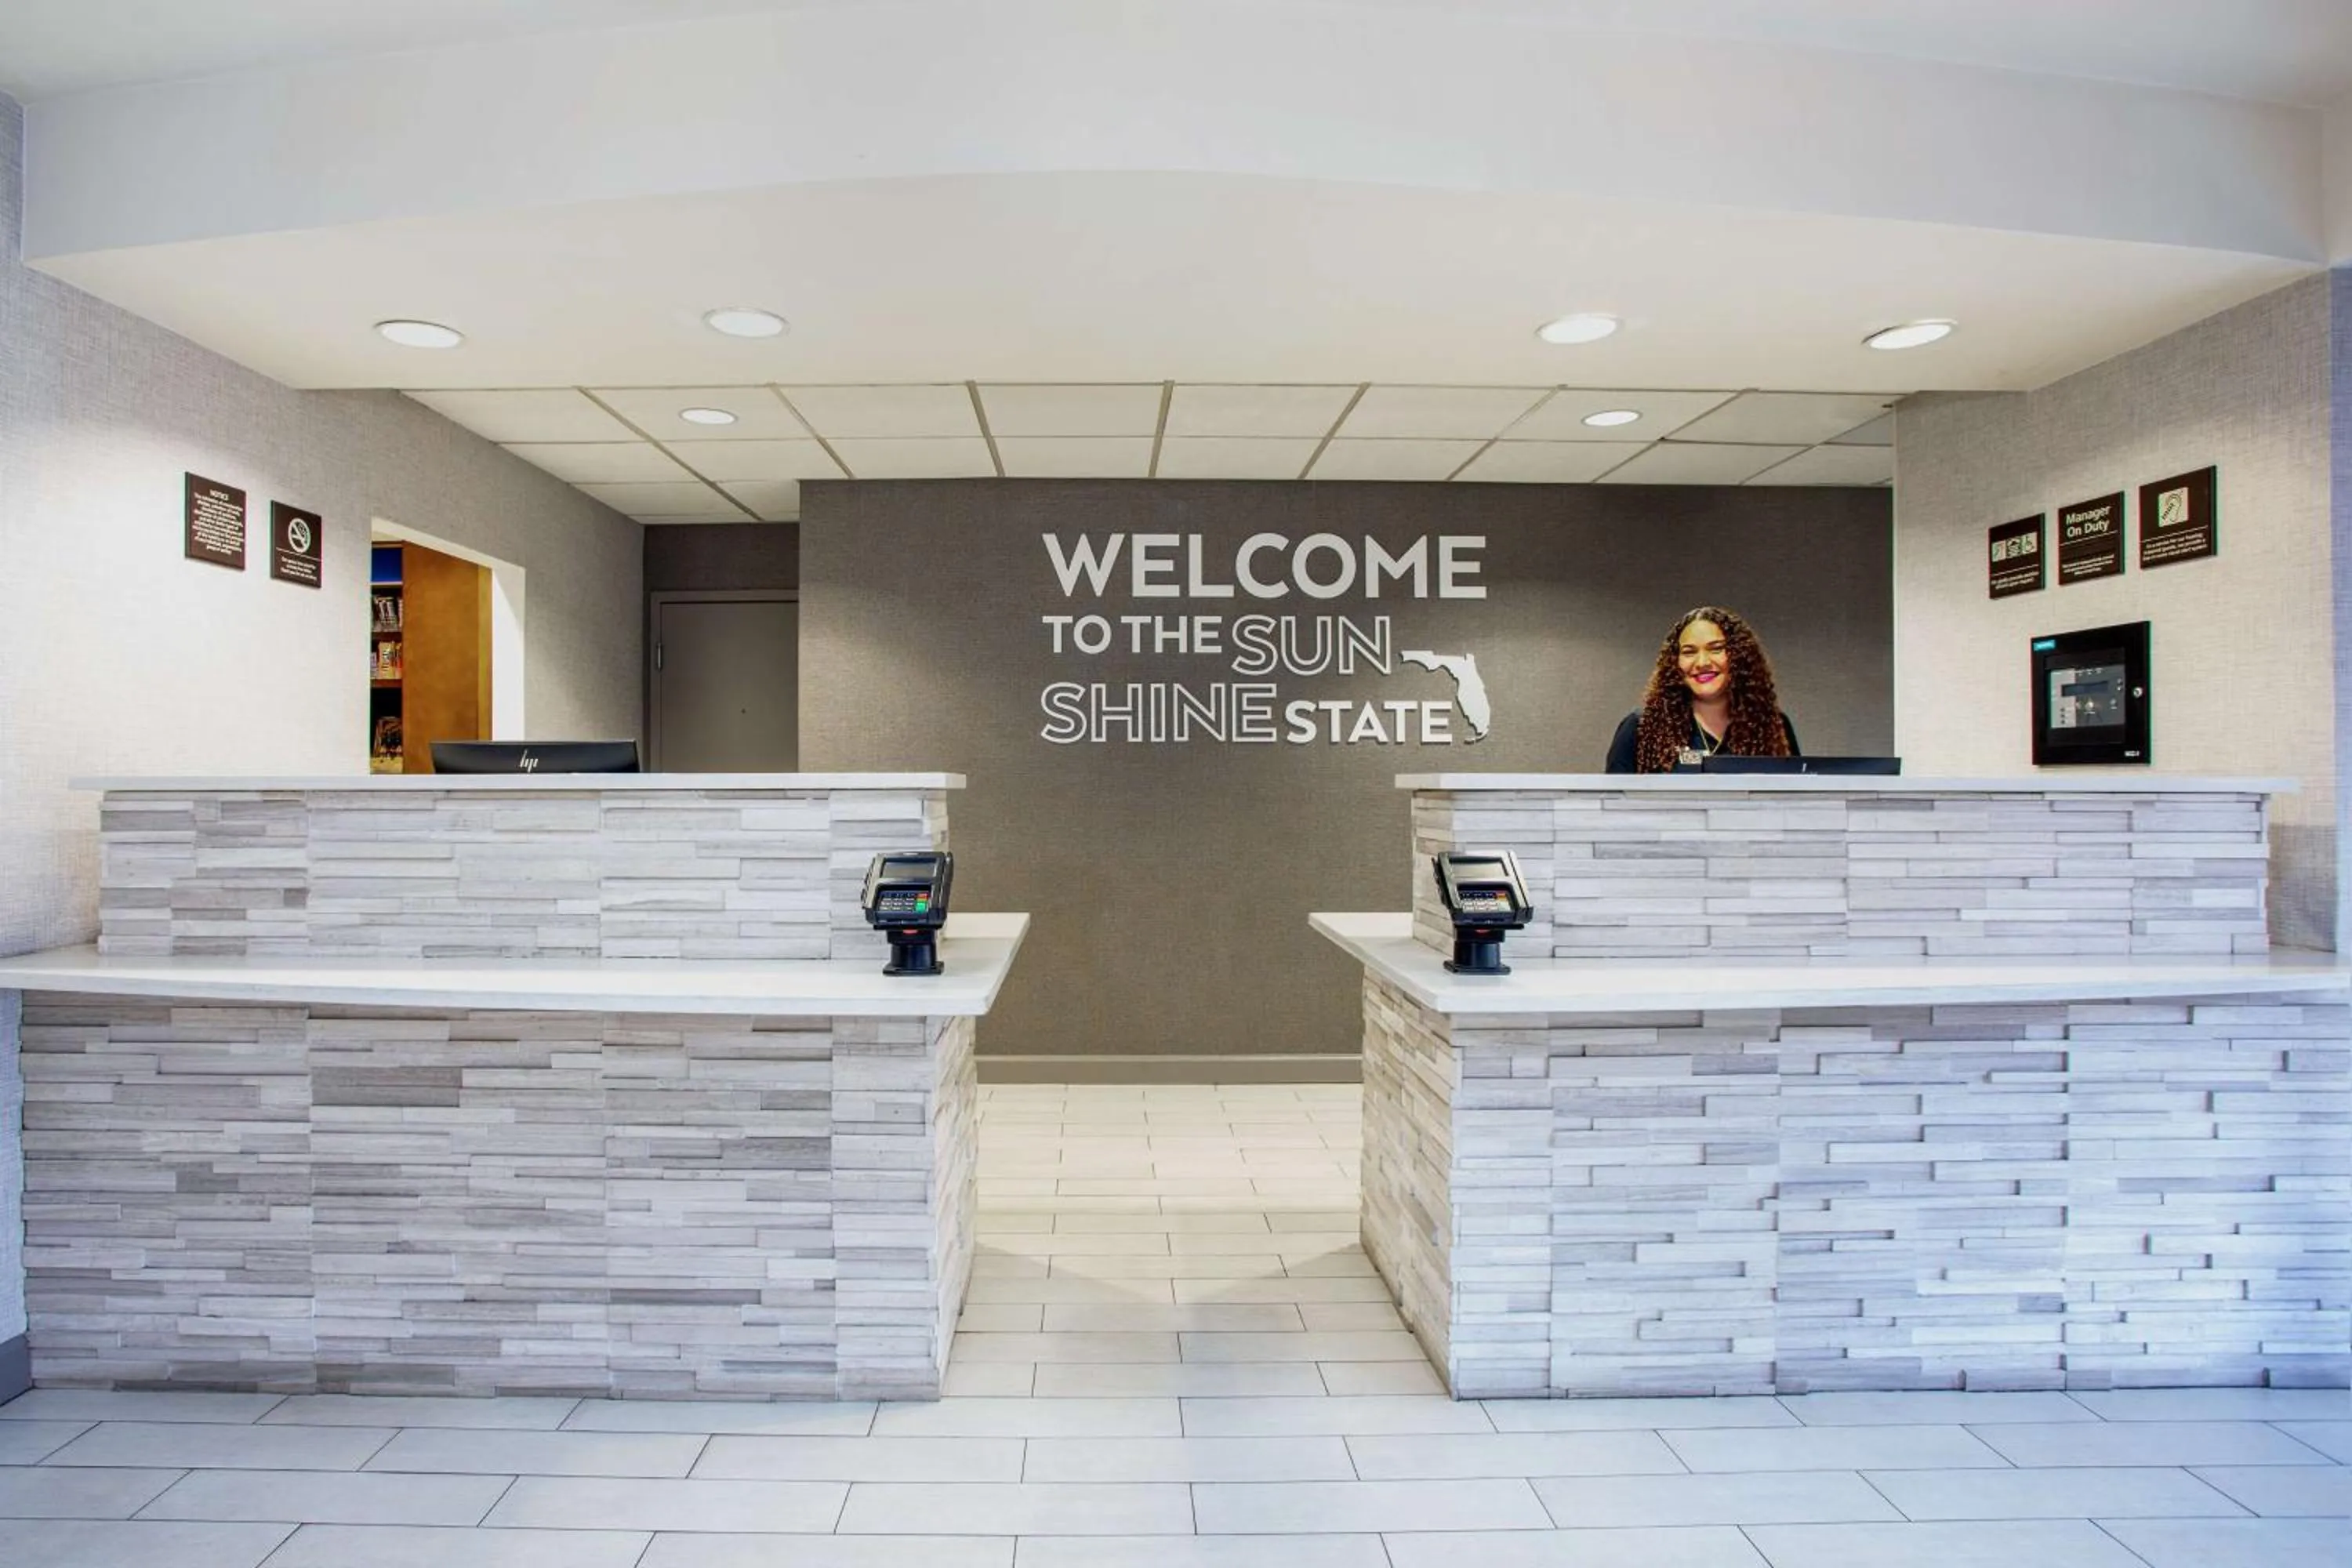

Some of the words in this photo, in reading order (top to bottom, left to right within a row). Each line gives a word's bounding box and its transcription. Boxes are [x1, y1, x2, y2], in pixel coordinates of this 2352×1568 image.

[2066, 506, 2111, 524] Manager
[2067, 526, 2082, 537] On
[2084, 520, 2110, 533] Duty
[1044, 534, 1487, 598] WELCOME
[1044, 616, 1112, 655] TO
[1122, 617, 1222, 653] THE
[1232, 615, 1392, 676] SUN
[1042, 683, 1277, 744] SHINE
[1287, 702, 1454, 743] STATE
[520, 749, 539, 773] hp
